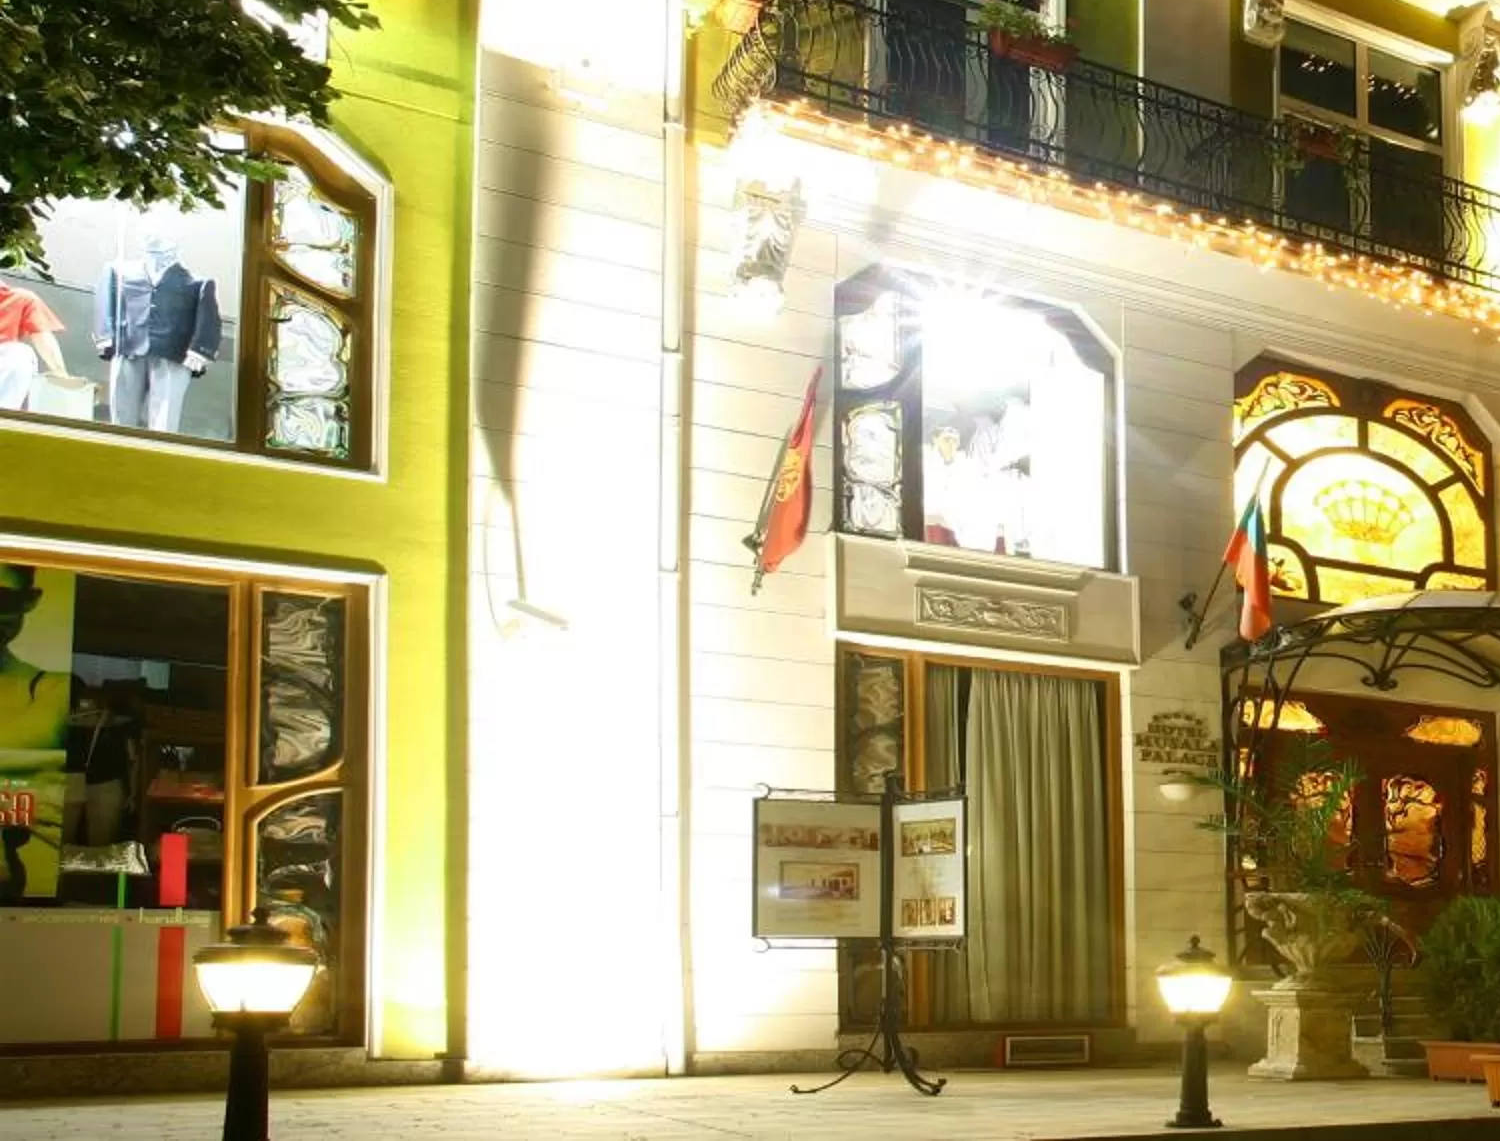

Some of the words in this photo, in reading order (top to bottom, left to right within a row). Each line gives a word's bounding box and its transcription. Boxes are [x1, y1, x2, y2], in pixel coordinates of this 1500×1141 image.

[1147, 722, 1209, 739] HOTEL
[1135, 733, 1219, 752] MUSALA
[1140, 748, 1218, 767] PALACE
